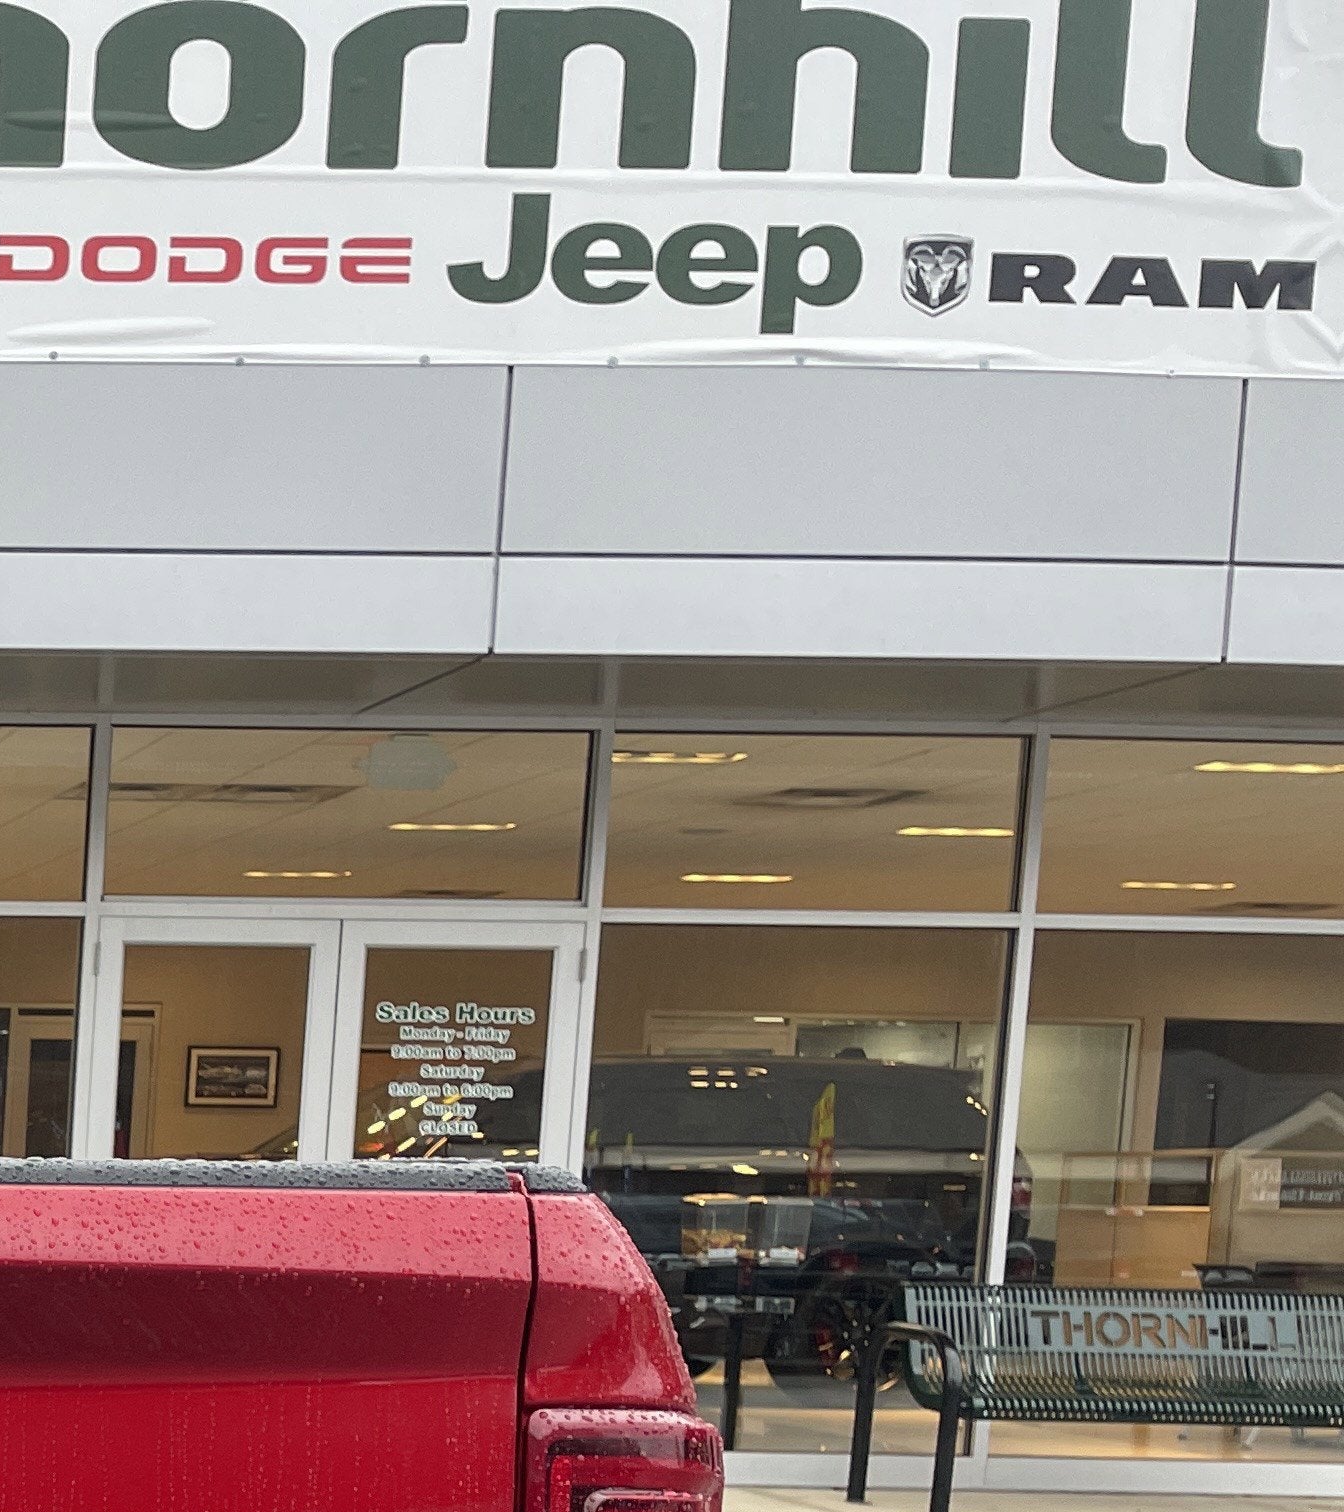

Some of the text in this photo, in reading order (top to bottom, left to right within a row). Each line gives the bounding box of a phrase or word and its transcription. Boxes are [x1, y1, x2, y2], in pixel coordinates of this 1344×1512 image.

[446, 192, 864, 335] Jeep
[986, 251, 1318, 312] RAM
[376, 1001, 536, 1025] Sales Hours
[420, 1063, 485, 1081] Saturday
[1030, 1309, 1297, 1351] THORNHILL
